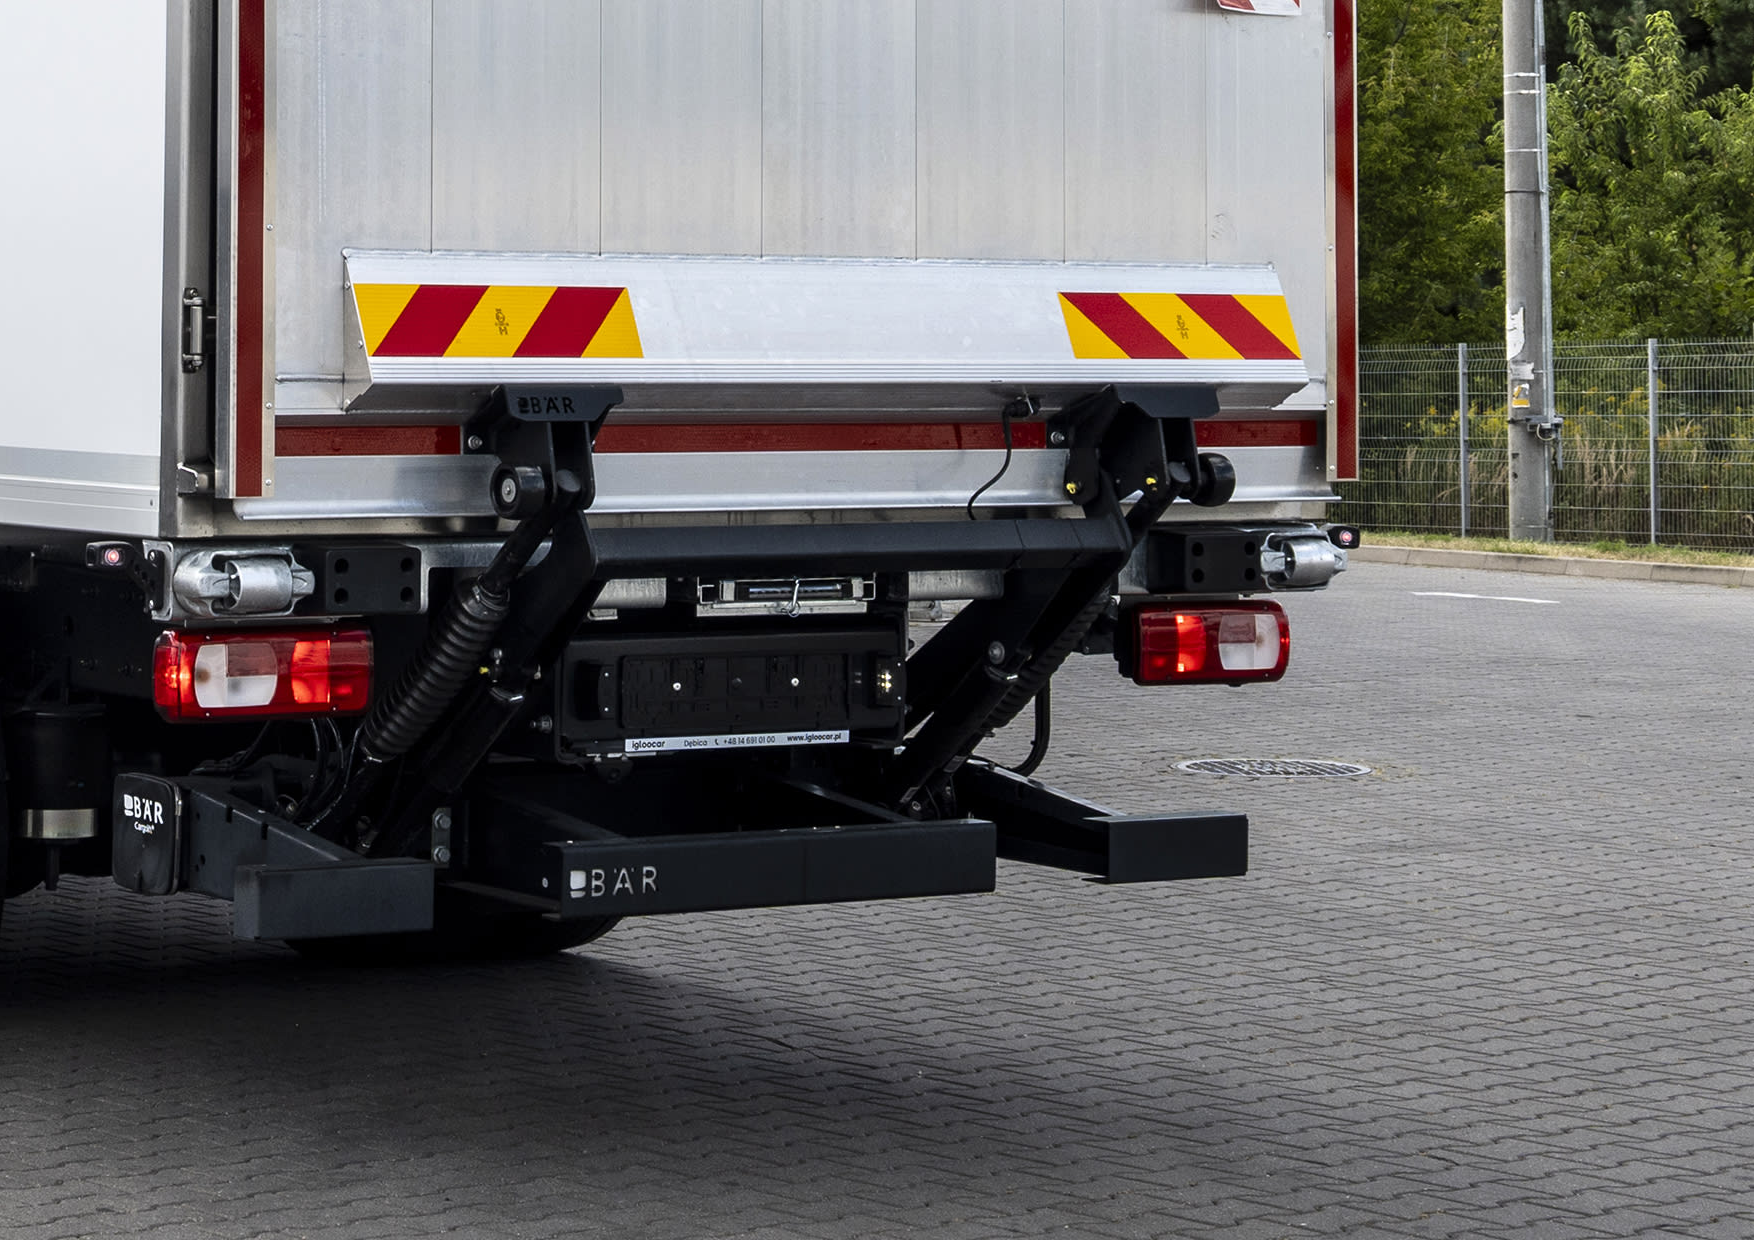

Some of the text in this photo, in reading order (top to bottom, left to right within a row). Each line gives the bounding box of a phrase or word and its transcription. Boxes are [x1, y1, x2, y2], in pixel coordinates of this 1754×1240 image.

[529, 396, 575, 414] BÄR
[631, 740, 666, 750] igloocar
[786, 732, 842, 743] www.igloocar.pl
[133, 796, 164, 825] BÄR
[591, 866, 658, 897] BÄR
